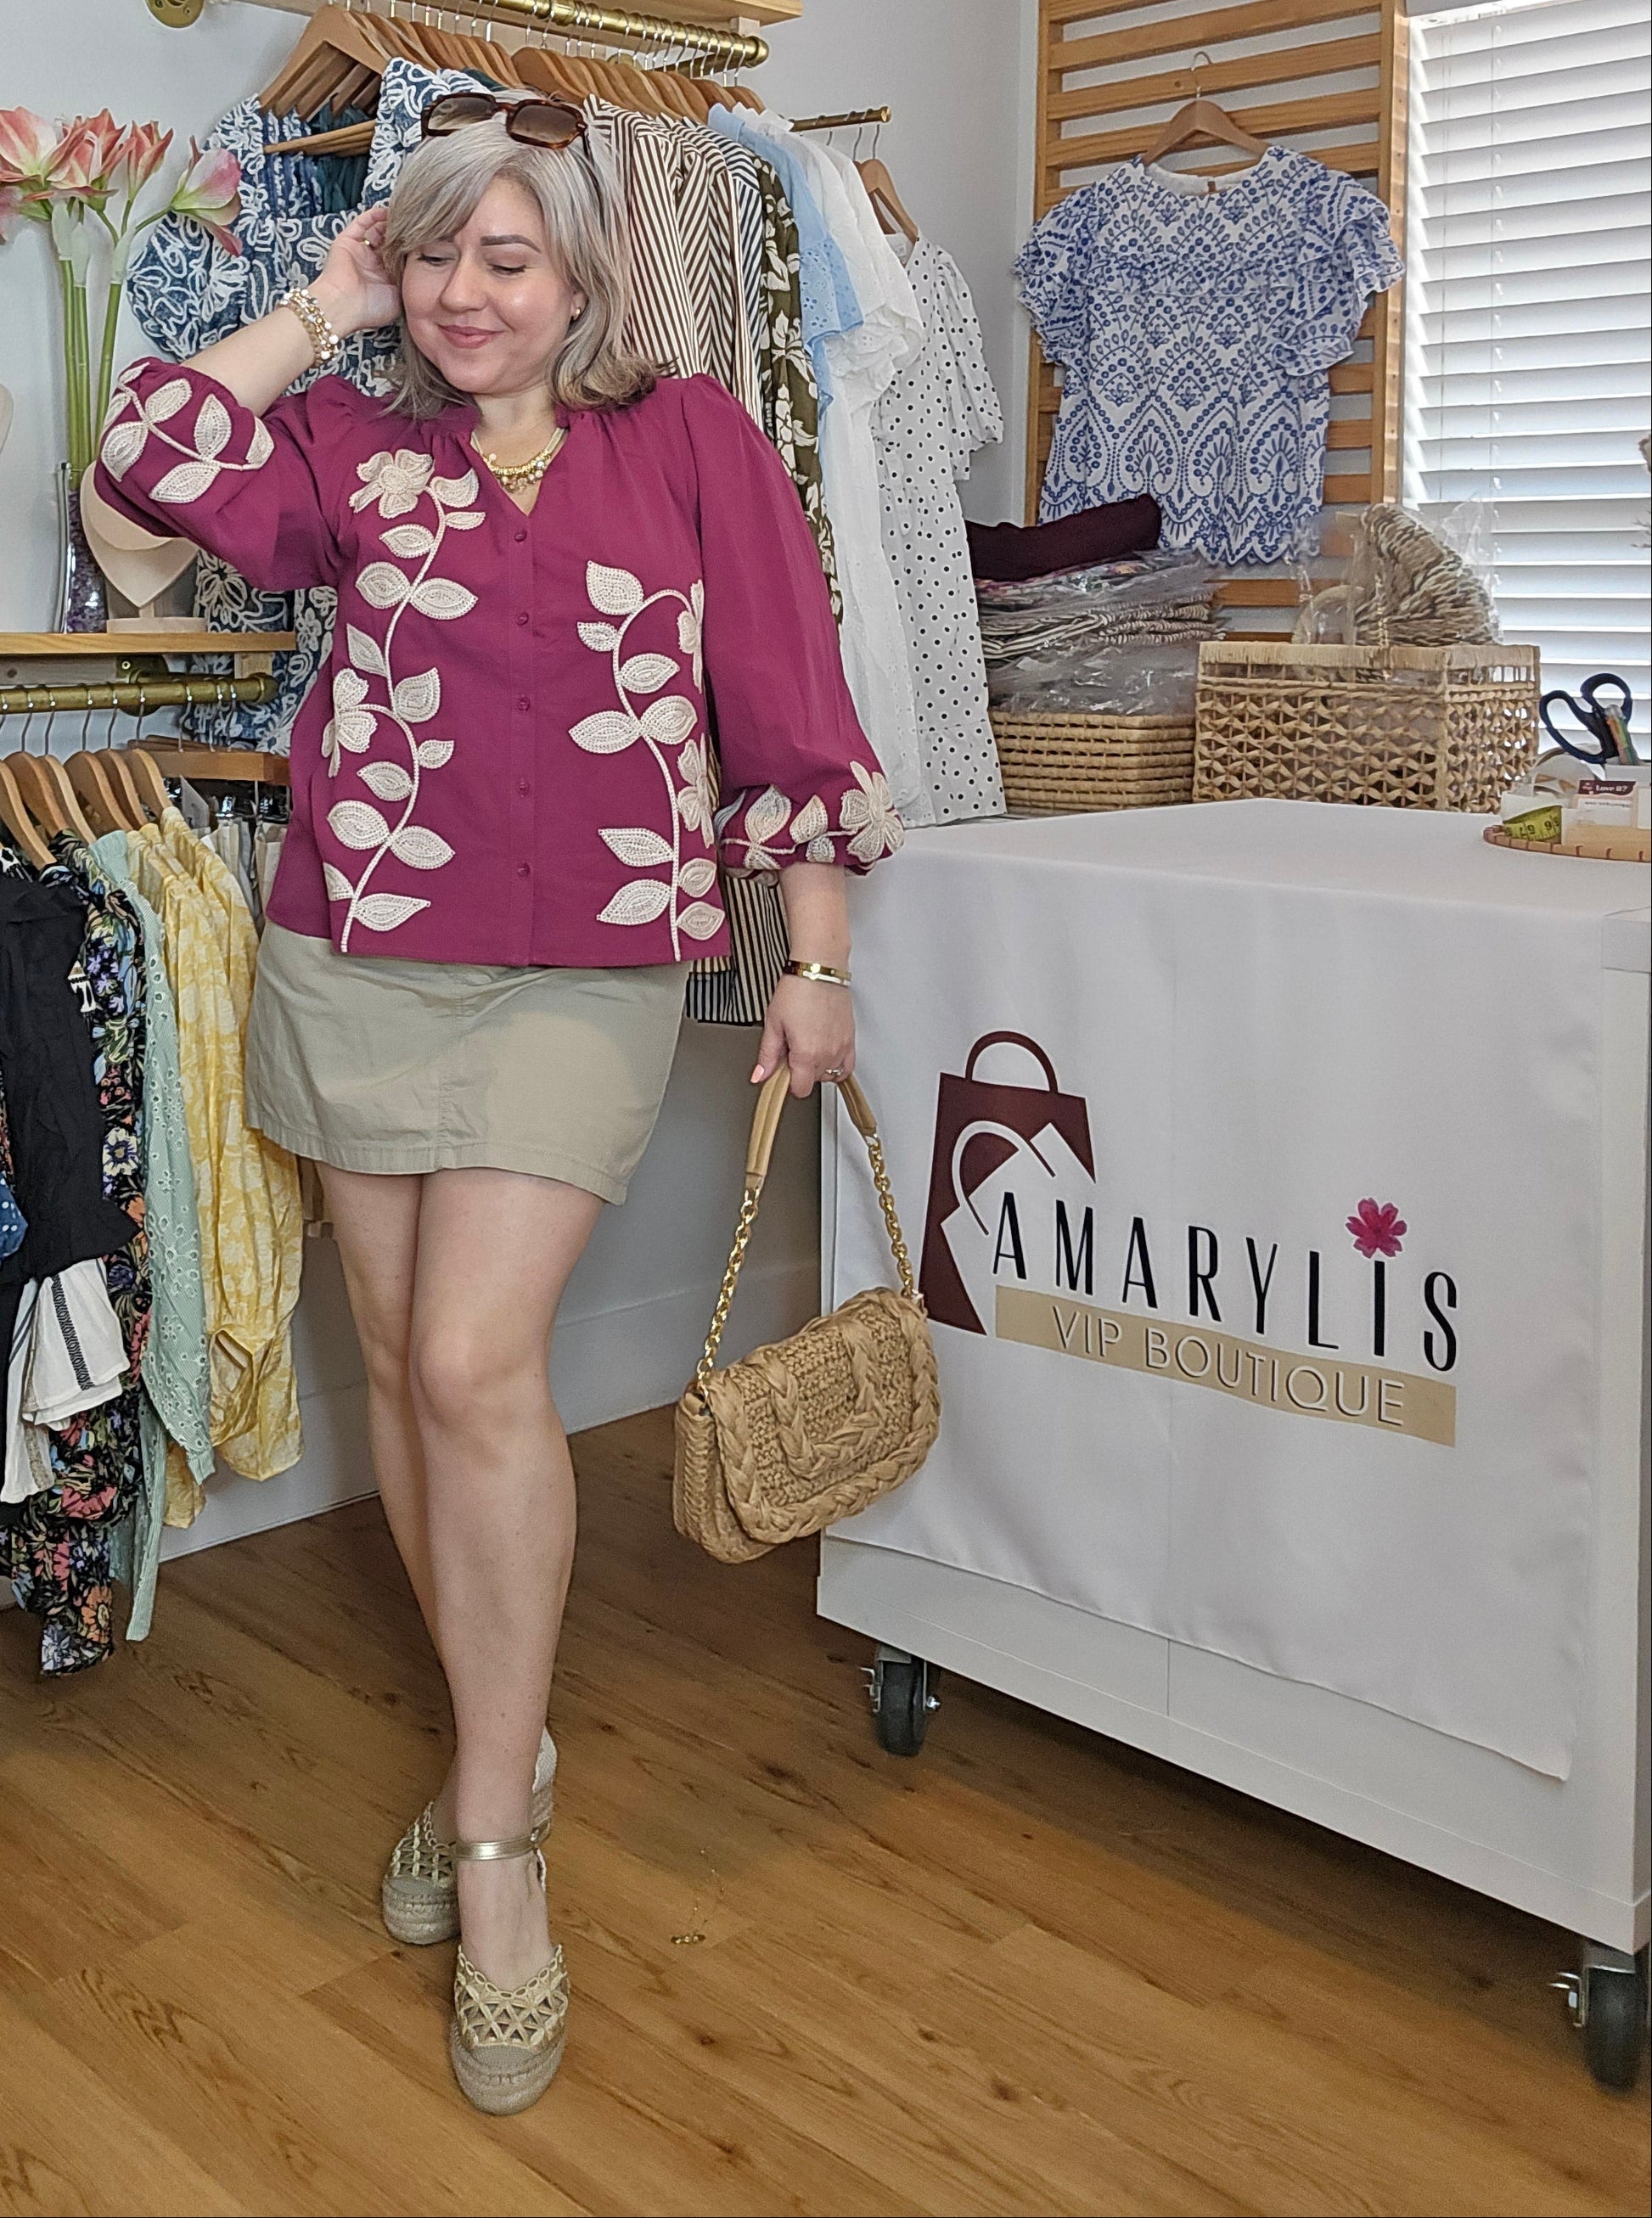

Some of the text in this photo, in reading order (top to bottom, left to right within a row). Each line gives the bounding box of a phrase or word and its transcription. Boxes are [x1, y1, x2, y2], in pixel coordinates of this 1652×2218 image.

[992, 1192, 1457, 1372] AMARYLIS
[1052, 1305, 1405, 1427] VIP BOUTIQUE
